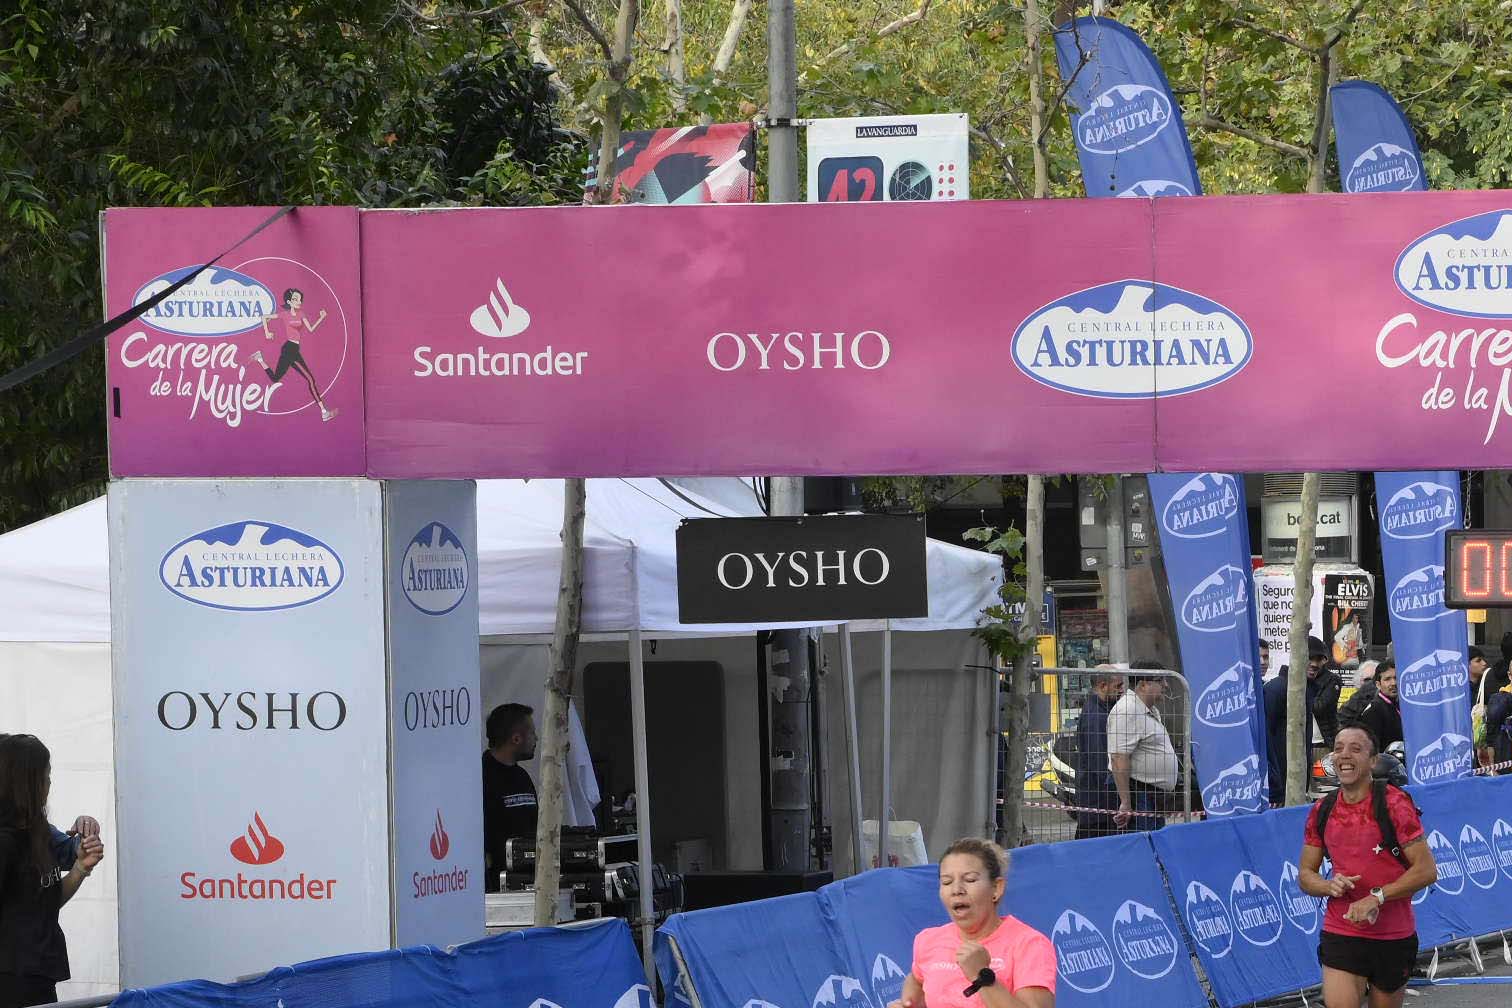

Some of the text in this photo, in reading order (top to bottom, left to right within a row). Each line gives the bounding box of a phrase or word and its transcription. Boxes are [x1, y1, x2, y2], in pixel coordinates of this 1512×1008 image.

[867, 126, 916, 136] VANGUARDIA
[144, 291, 264, 318] ASTURIANA
[1067, 320, 1225, 332] CENTRAL LECHERA
[120, 332, 239, 370] Carrera
[414, 348, 588, 377] Santander
[706, 330, 891, 372] OYSHO
[1030, 328, 1233, 368] ASTURIANA
[150, 368, 283, 427] de la Mujer
[1421, 373, 1455, 410] de
[1463, 382, 1488, 410] la
[1288, 512, 1341, 525] b.cat
[174, 554, 330, 588] ASTURIANA
[202, 552, 324, 560] CENTRAL LECHERA
[717, 548, 890, 591] OYSHO
[407, 562, 464, 591] ASTURIANA
[1338, 584, 1368, 596] ELVIS
[1264, 601, 1279, 610] que
[1268, 640, 1283, 650] ste
[157, 691, 346, 731] OYSHO
[404, 686, 470, 732] OYSHO
[180, 872, 336, 900] Santander
[413, 865, 469, 899] Santander
[1057, 944, 1112, 976] ASTURIANA
